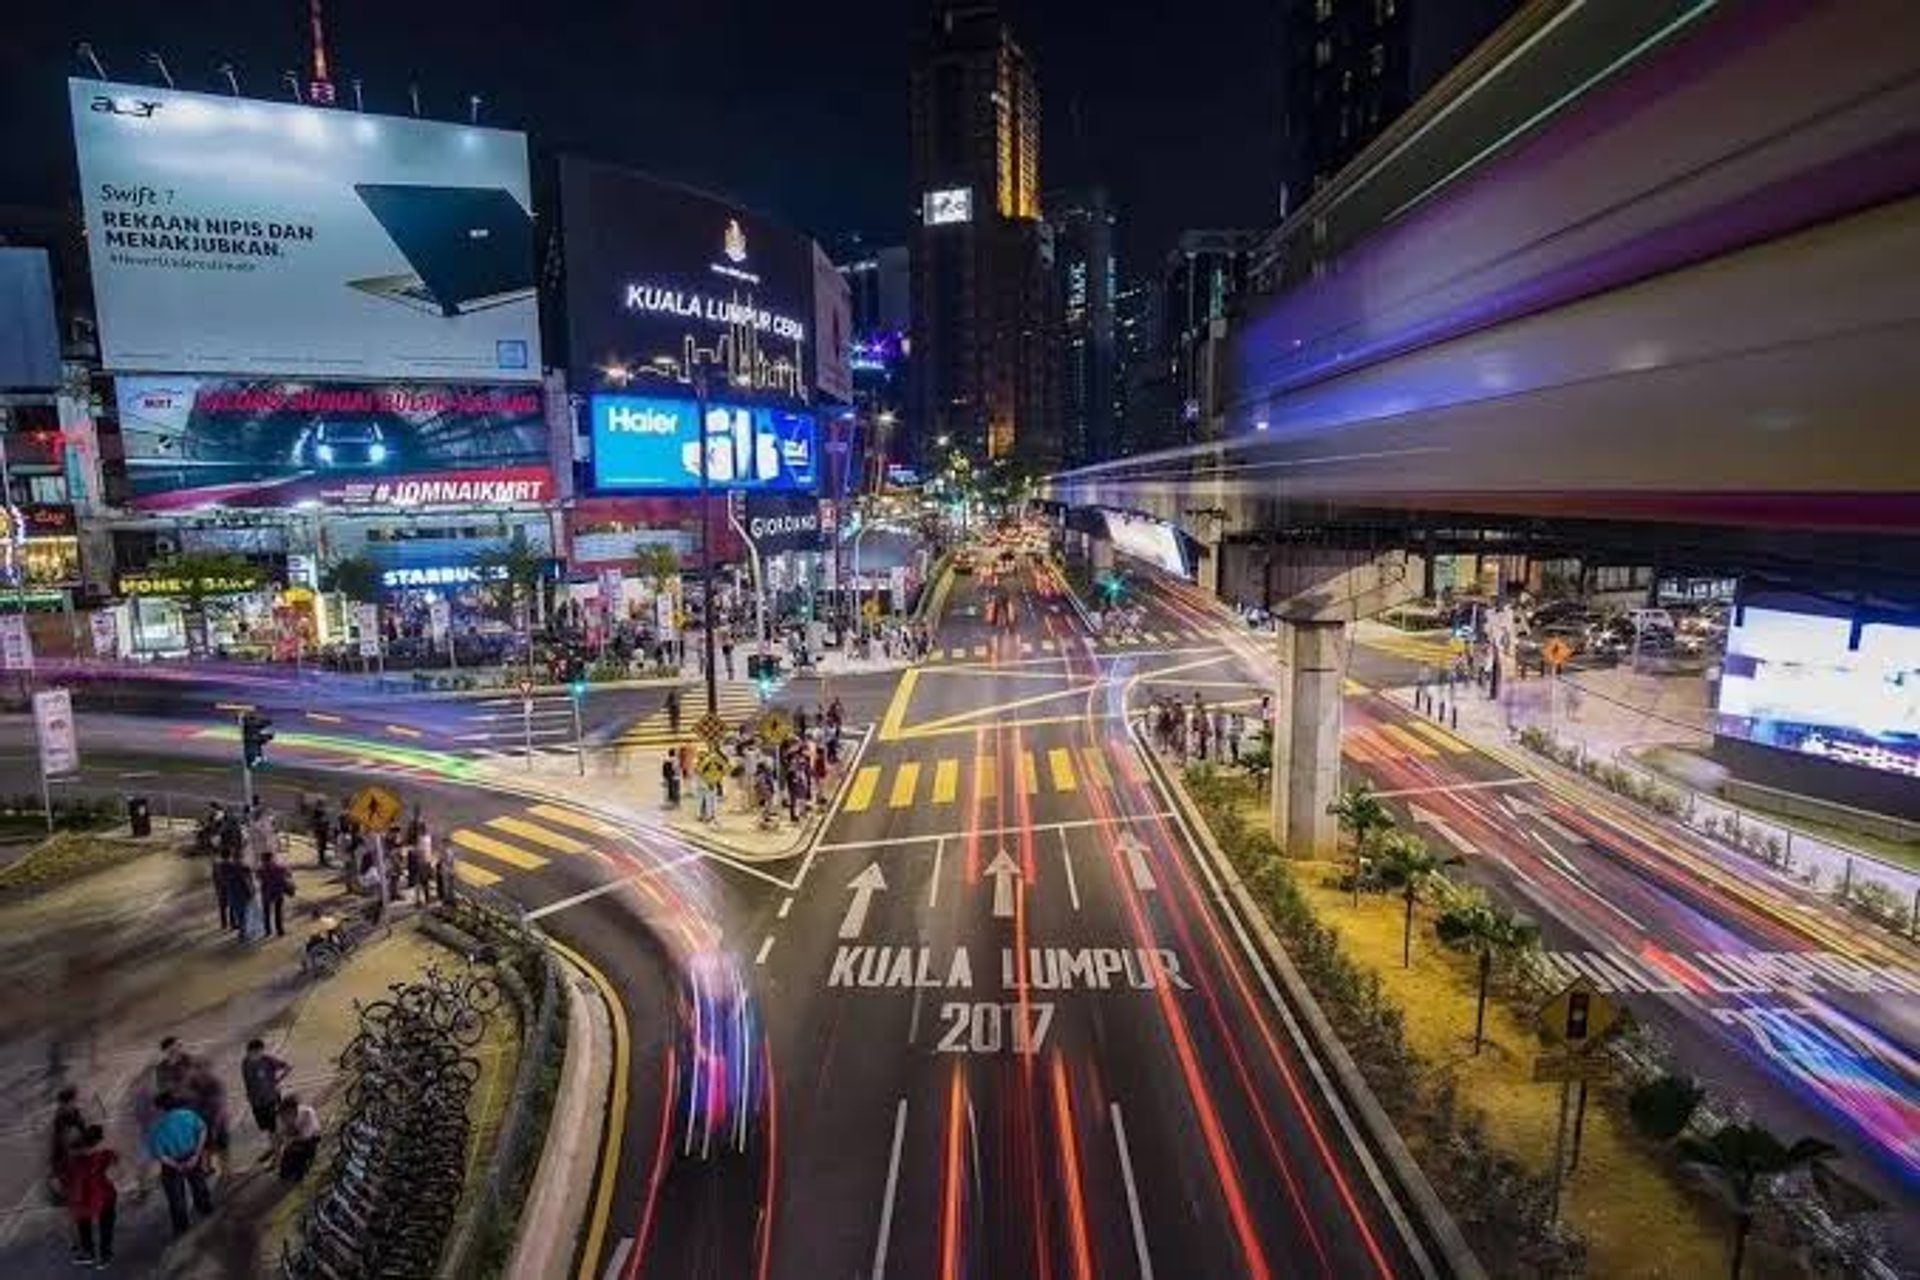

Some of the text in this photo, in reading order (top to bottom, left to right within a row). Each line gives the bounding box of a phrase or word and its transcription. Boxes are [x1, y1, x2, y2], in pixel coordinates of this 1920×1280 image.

[102, 184, 158, 208] Swift
[102, 210, 315, 241] REKAAN NIPIS DAN
[627, 284, 702, 318] KUALA
[706, 298, 772, 332] LUMPUR
[608, 407, 678, 433] Haier
[383, 565, 509, 587] STARBUCS
[827, 946, 1194, 990] KUALA LUMPUR
[937, 1002, 1056, 1053] 2017
